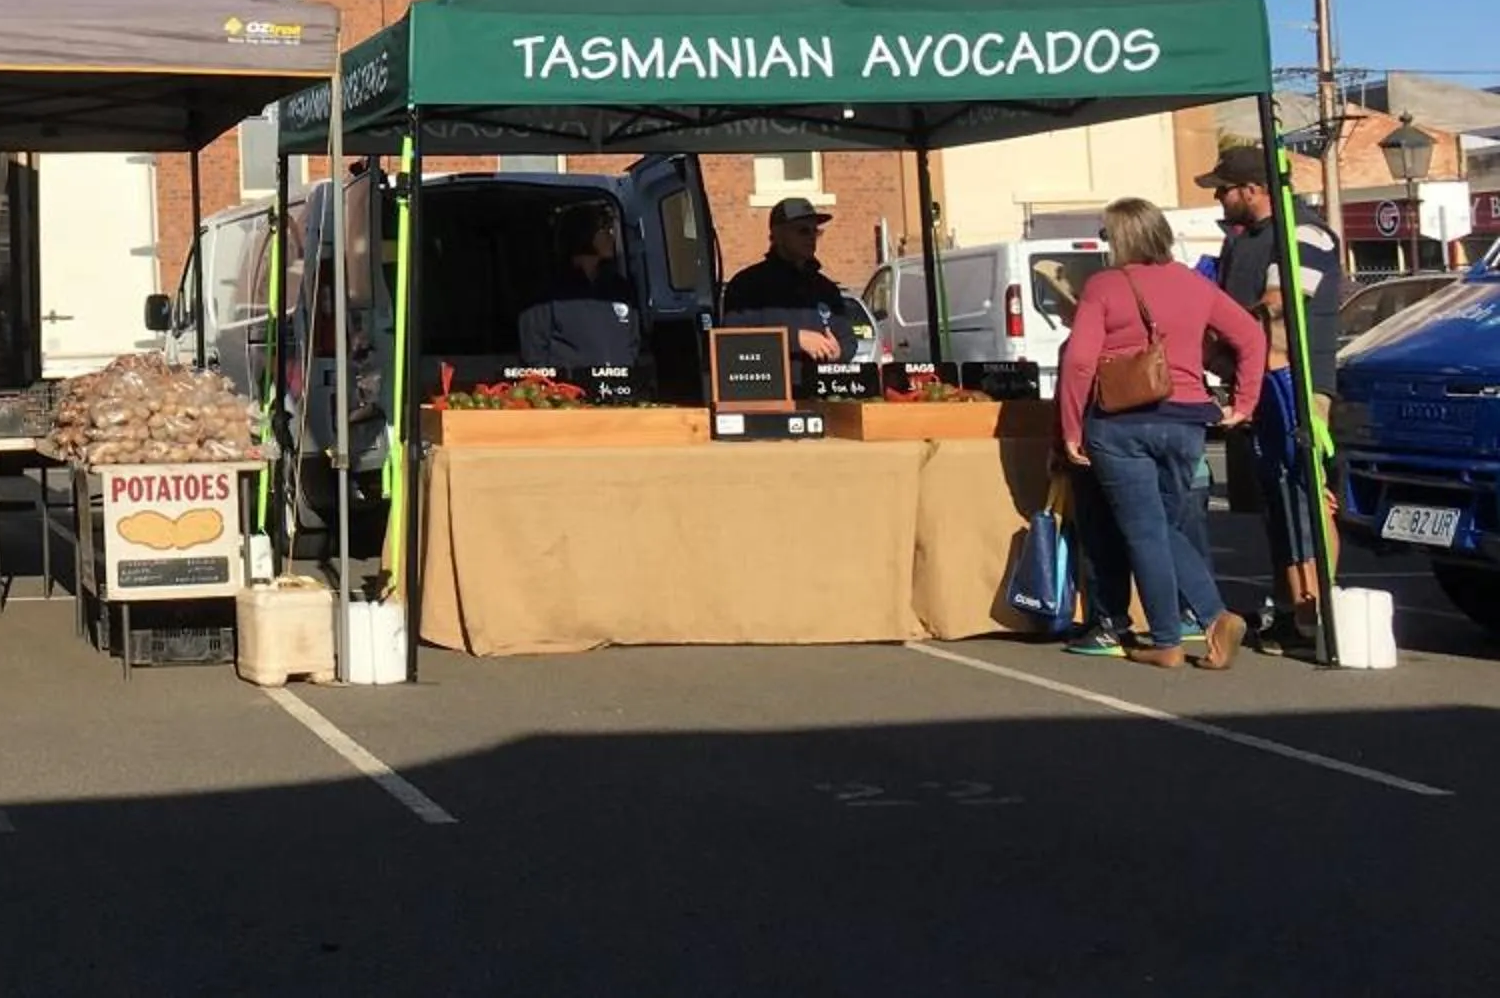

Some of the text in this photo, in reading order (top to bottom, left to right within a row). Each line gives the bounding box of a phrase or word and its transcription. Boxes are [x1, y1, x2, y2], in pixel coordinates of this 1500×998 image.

[512, 28, 1162, 79] TASMANIAN AVOCADOS
[503, 366, 557, 378] SECONDS
[590, 366, 629, 378] LARGE
[904, 363, 936, 374] BAGS
[111, 473, 230, 503] POTATOES
